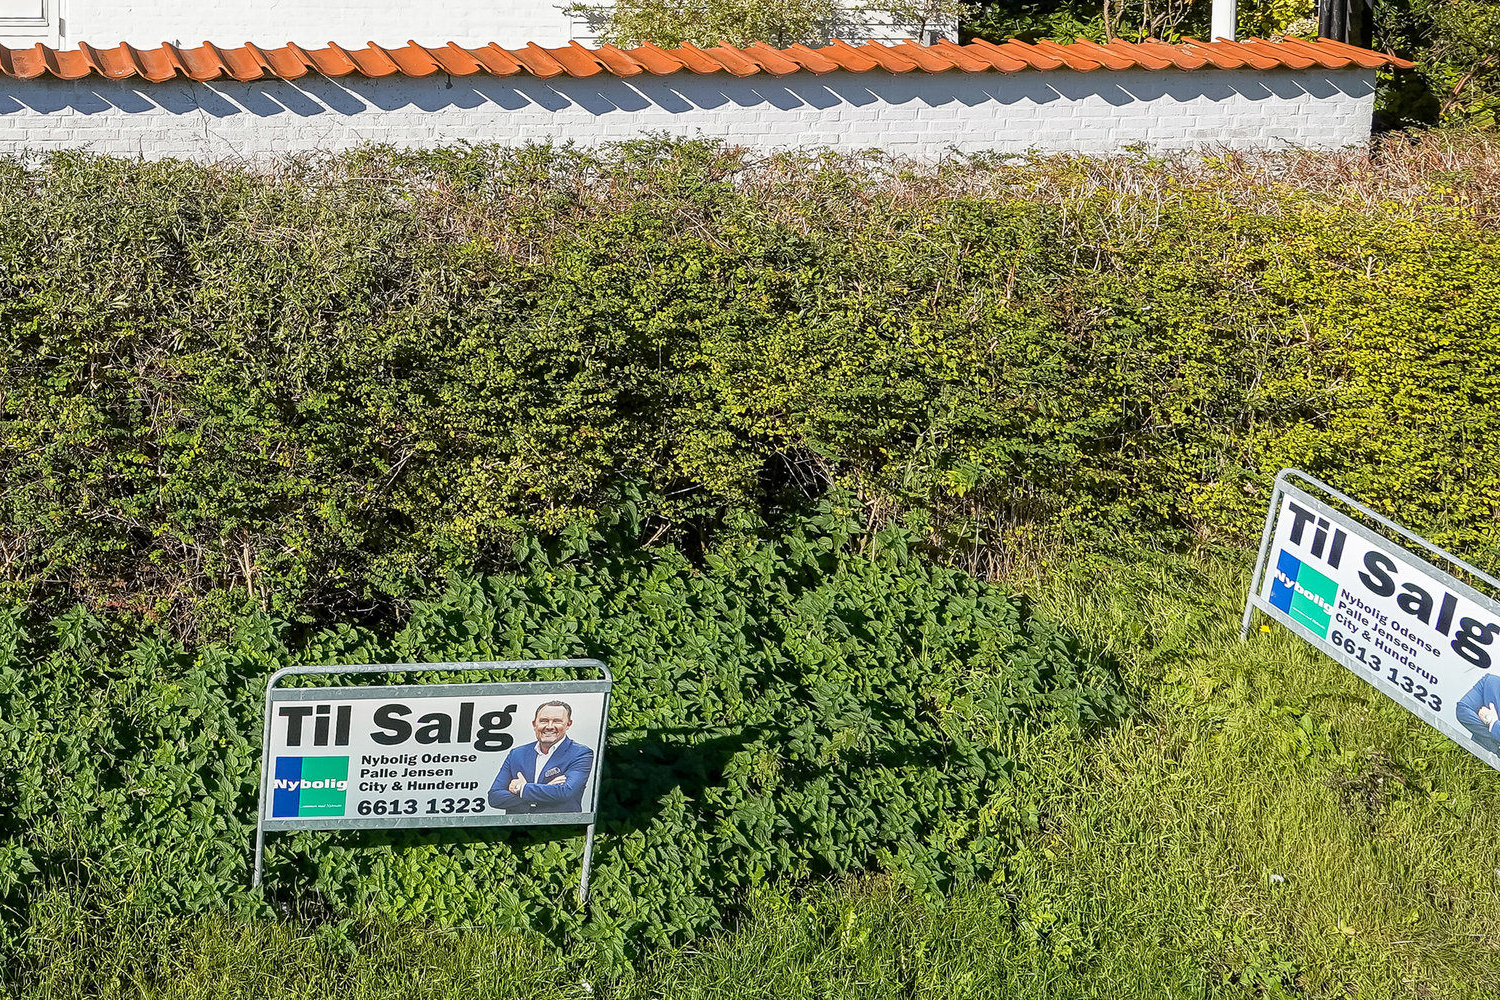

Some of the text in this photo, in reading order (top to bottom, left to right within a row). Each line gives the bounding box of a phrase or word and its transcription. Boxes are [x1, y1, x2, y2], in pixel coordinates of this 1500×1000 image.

[1274, 568, 1334, 616] Nybolig
[1288, 502, 1500, 669] Til Salg
[1338, 600, 1369, 626] Palle
[1371, 623, 1417, 657] Jensen
[1341, 588, 1389, 626] Nybolig
[1391, 620, 1441, 657] Odense
[1331, 630, 1443, 712] 6613 1323
[1335, 613, 1359, 634] City
[1361, 630, 1371, 642] &
[1374, 638, 1439, 685] Hunderup
[278, 702, 518, 752] Til Salg
[360, 768, 453, 778] Palle Jensen
[361, 753, 478, 767] Nybolig Odense
[273, 778, 348, 792] Nybolig
[357, 798, 486, 815] 6613 1323
[359, 780, 479, 793] City & Hunderup
